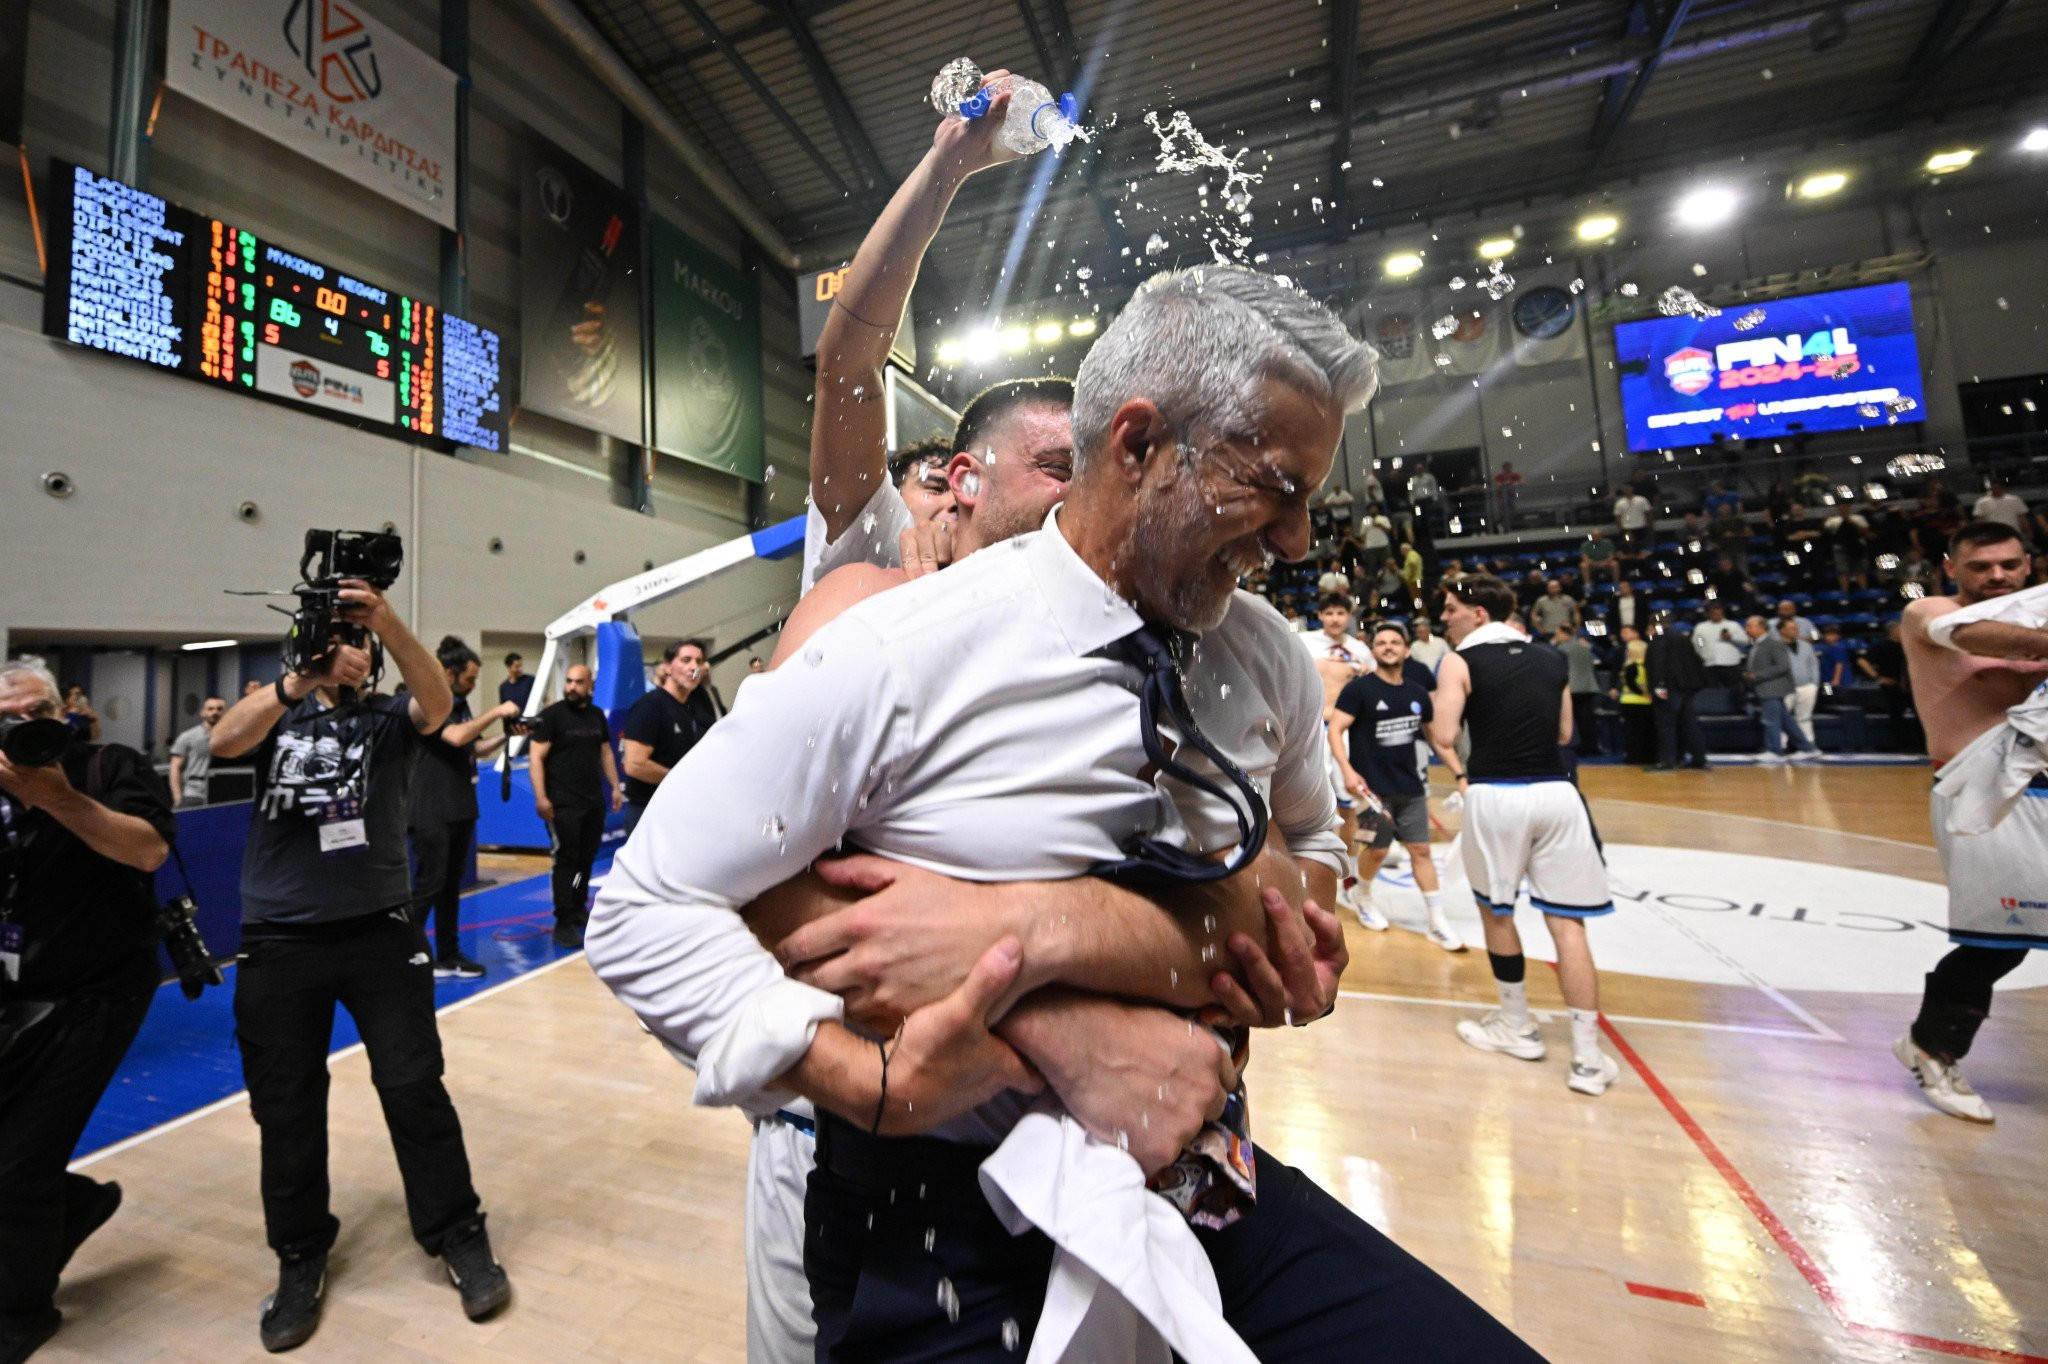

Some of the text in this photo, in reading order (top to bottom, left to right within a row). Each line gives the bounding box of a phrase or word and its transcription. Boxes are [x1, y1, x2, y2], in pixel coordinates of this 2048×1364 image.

[192, 26, 443, 182] ΤΡΑΠΕΖΑ ΚΑΡΔΙΤΣΑΣ
[192, 53, 443, 198] ΣΥΝΕΤΑΙΡΙΣΤΙΚΗ
[265, 323, 390, 378] 5 5
[270, 298, 301, 327] 86
[325, 317, 338, 335] 4
[366, 330, 390, 356] 76
[1716, 328, 1857, 371] FIN4L
